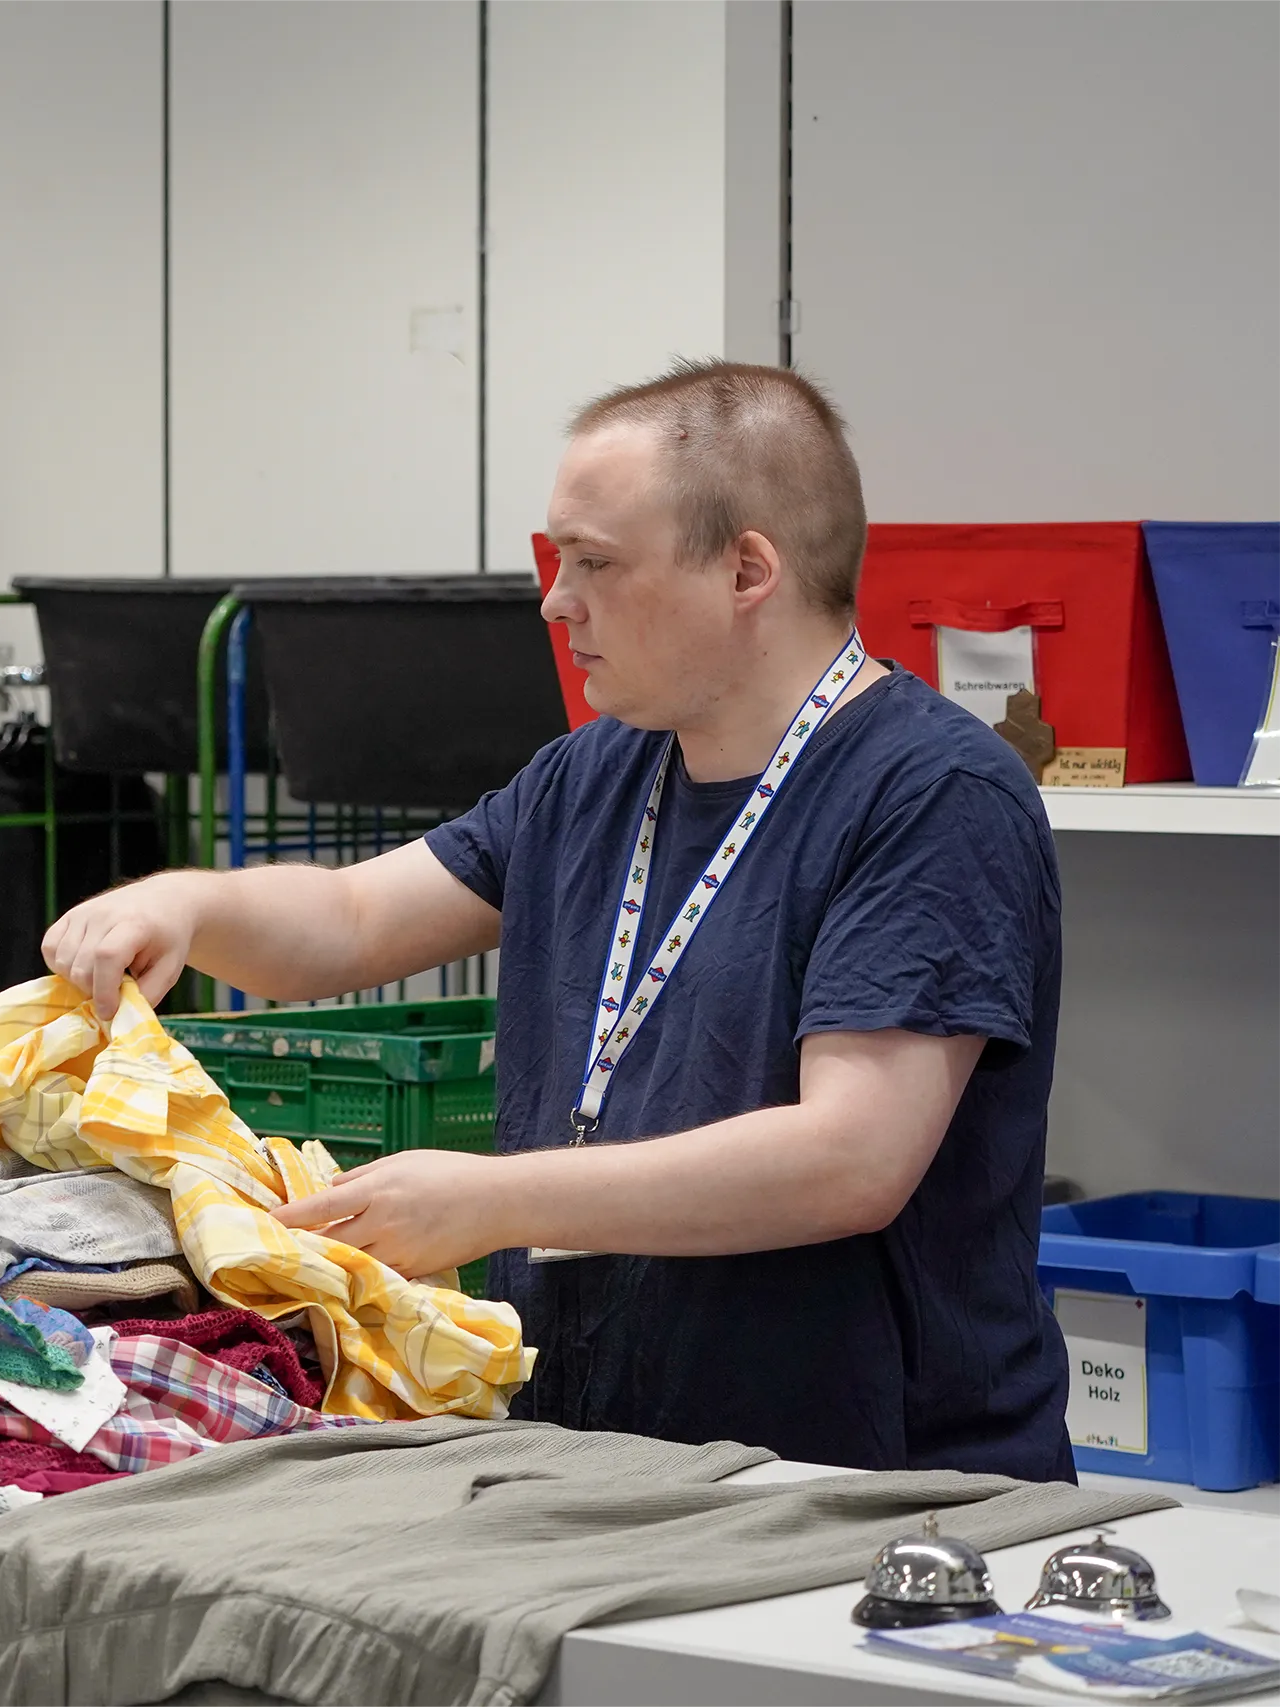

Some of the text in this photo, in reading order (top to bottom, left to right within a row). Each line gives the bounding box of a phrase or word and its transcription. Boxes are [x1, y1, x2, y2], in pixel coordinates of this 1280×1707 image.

[954, 681, 1025, 692] Schreibwaren
[1081, 1360, 1125, 1380] Deko
[1088, 1385, 1120, 1402] Holz
